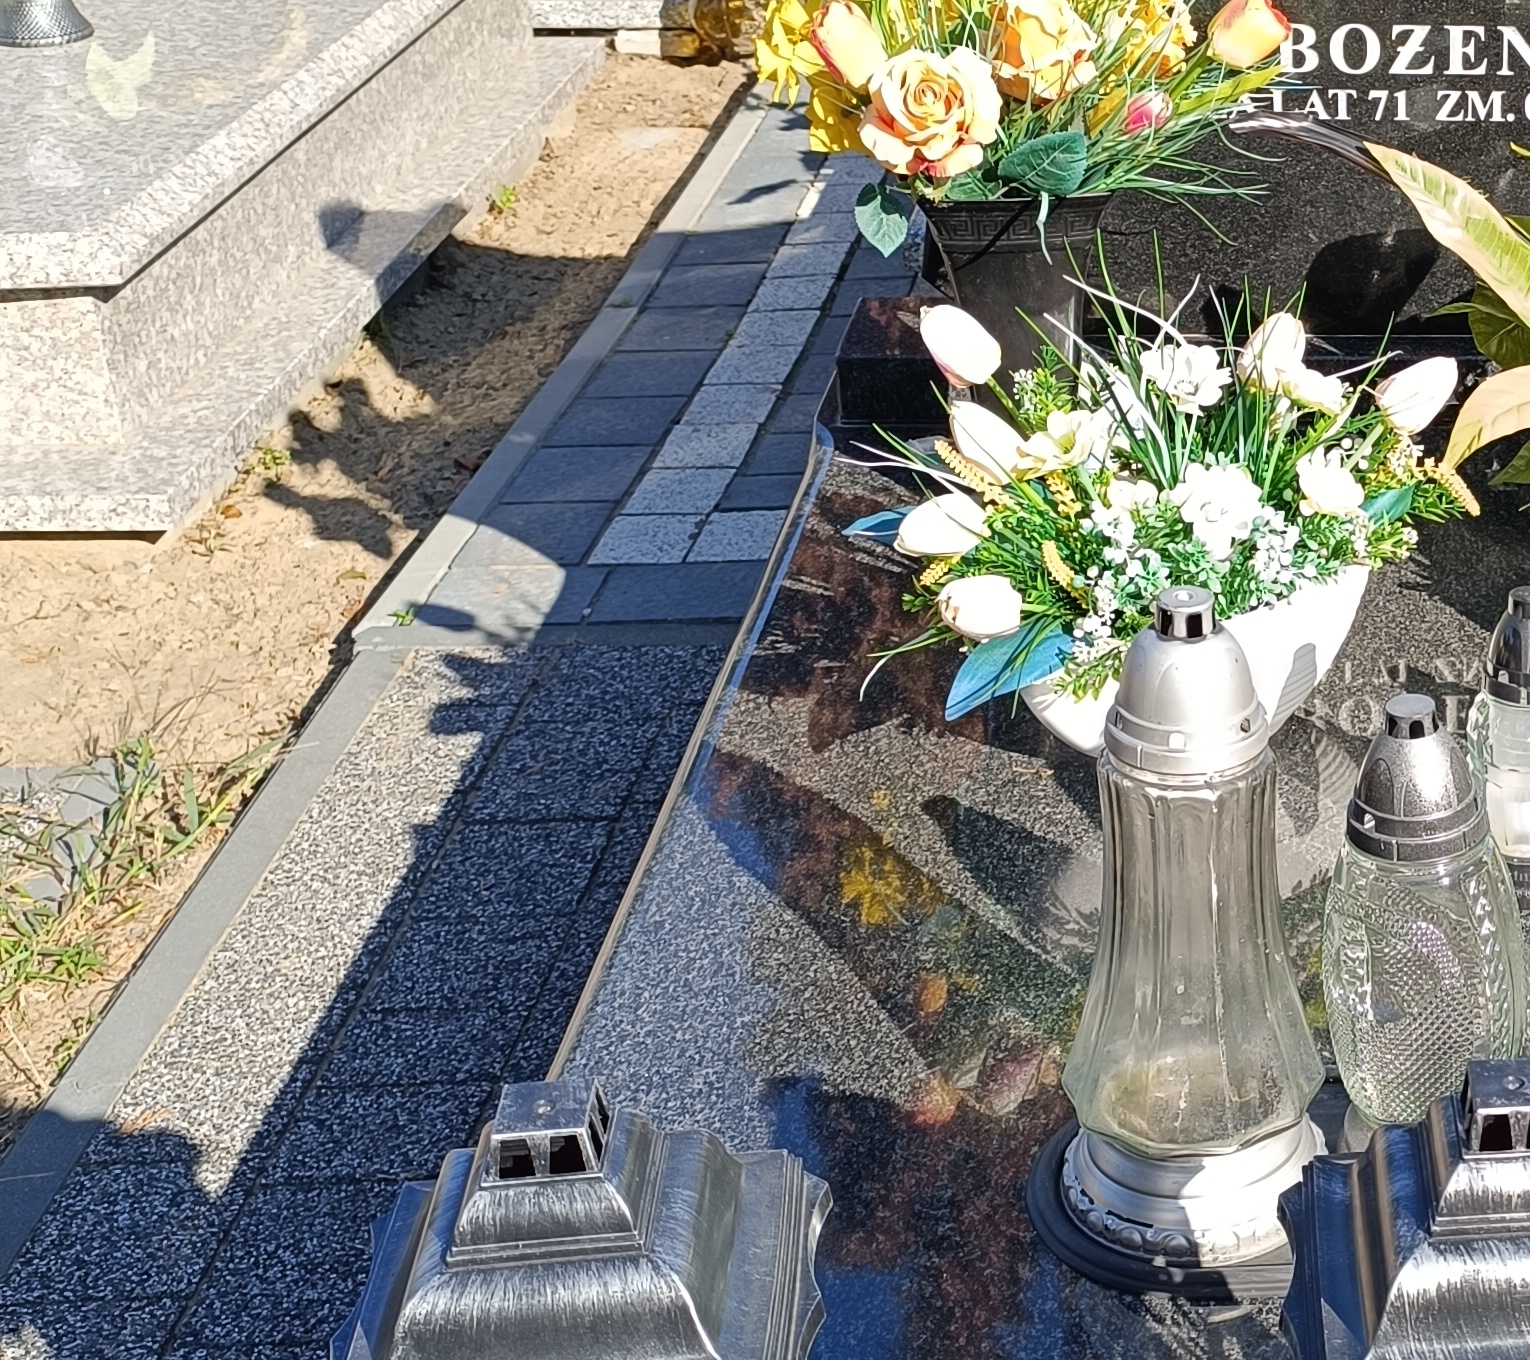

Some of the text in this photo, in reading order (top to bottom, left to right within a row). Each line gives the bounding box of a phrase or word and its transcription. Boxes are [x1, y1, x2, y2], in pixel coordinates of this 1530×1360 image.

[1268, 87, 1359, 122] LAT
[1366, 88, 1412, 122] 71
[1433, 89, 1517, 124] ZM.
